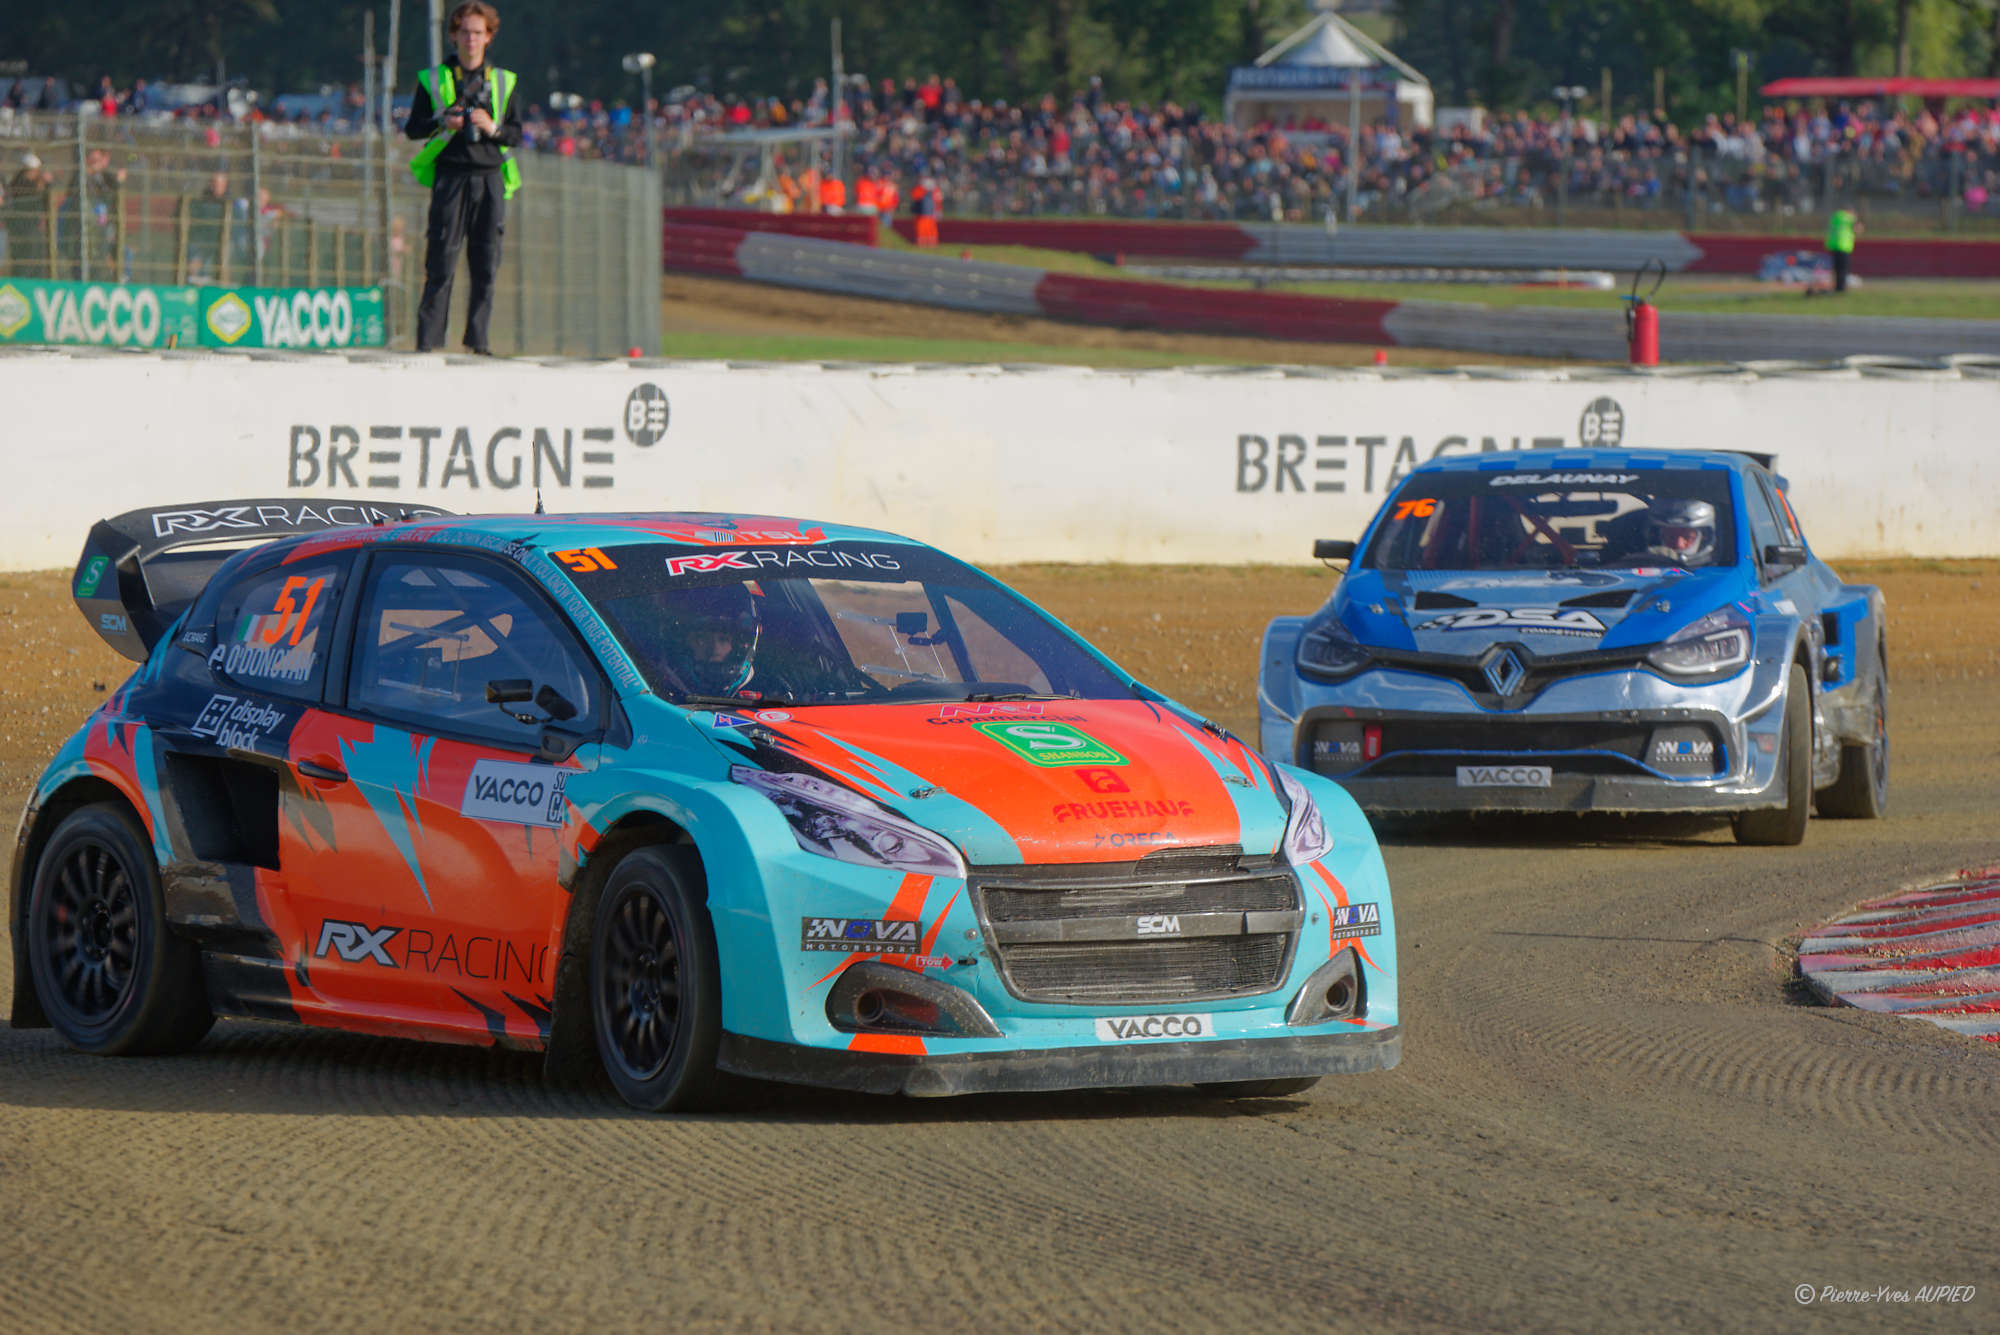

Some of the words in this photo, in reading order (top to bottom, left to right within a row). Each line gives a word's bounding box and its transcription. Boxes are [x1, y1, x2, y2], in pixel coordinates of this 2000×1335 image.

[34, 286, 161, 346] YACCO
[254, 290, 352, 346] YACCO
[287, 425, 614, 489] BRETAGNE
[1489, 474, 1640, 486] DELAUNAY
[152, 506, 259, 537] RX
[1393, 498, 1437, 520] 76
[554, 547, 618, 572] 51
[665, 551, 758, 576] RX
[752, 550, 900, 570] RACING
[264, 576, 325, 646] 51
[546, 574, 574, 600] KNOW
[566, 594, 590, 622] YOUR
[583, 616, 606, 642] TRUE
[1449, 608, 1608, 631] DSA
[101, 614, 126, 632] SCM
[1519, 627, 1604, 638] COMPETITION
[226, 644, 318, 681] O'DONOVAN
[230, 699, 286, 734] display
[216, 722, 260, 752] block
[474, 774, 544, 807] YACCO
[1468, 769, 1543, 785] YACCO
[1136, 916, 1181, 934] SCM
[314, 918, 404, 969] RX
[806, 943, 917, 953] MOTORSPORT
[1107, 1016, 1202, 1039] YACCO
